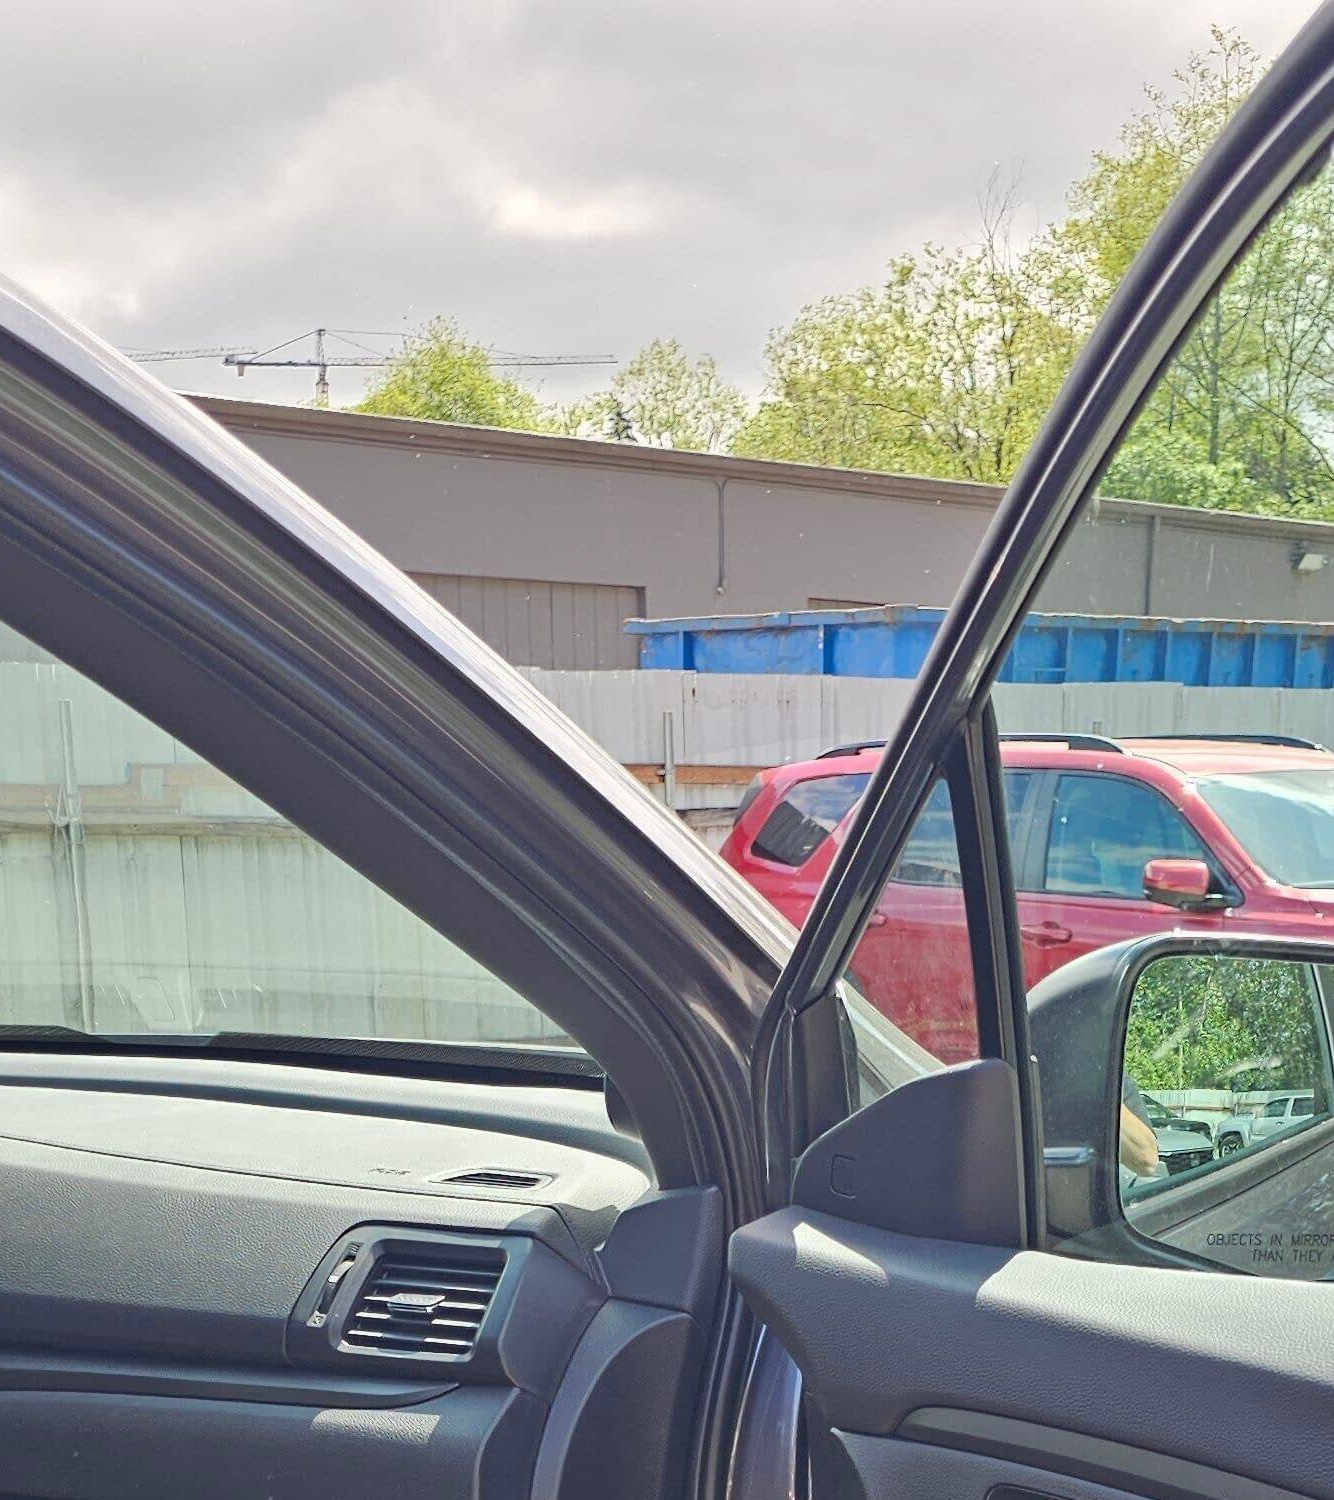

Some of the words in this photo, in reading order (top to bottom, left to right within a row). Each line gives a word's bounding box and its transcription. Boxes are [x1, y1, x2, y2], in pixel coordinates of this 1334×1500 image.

[1206, 1233, 1263, 1247] OBJECTS
[1270, 1233, 1283, 1247] IN
[1250, 1248, 1284, 1263] THAN
[1292, 1248, 1324, 1263] THEY
